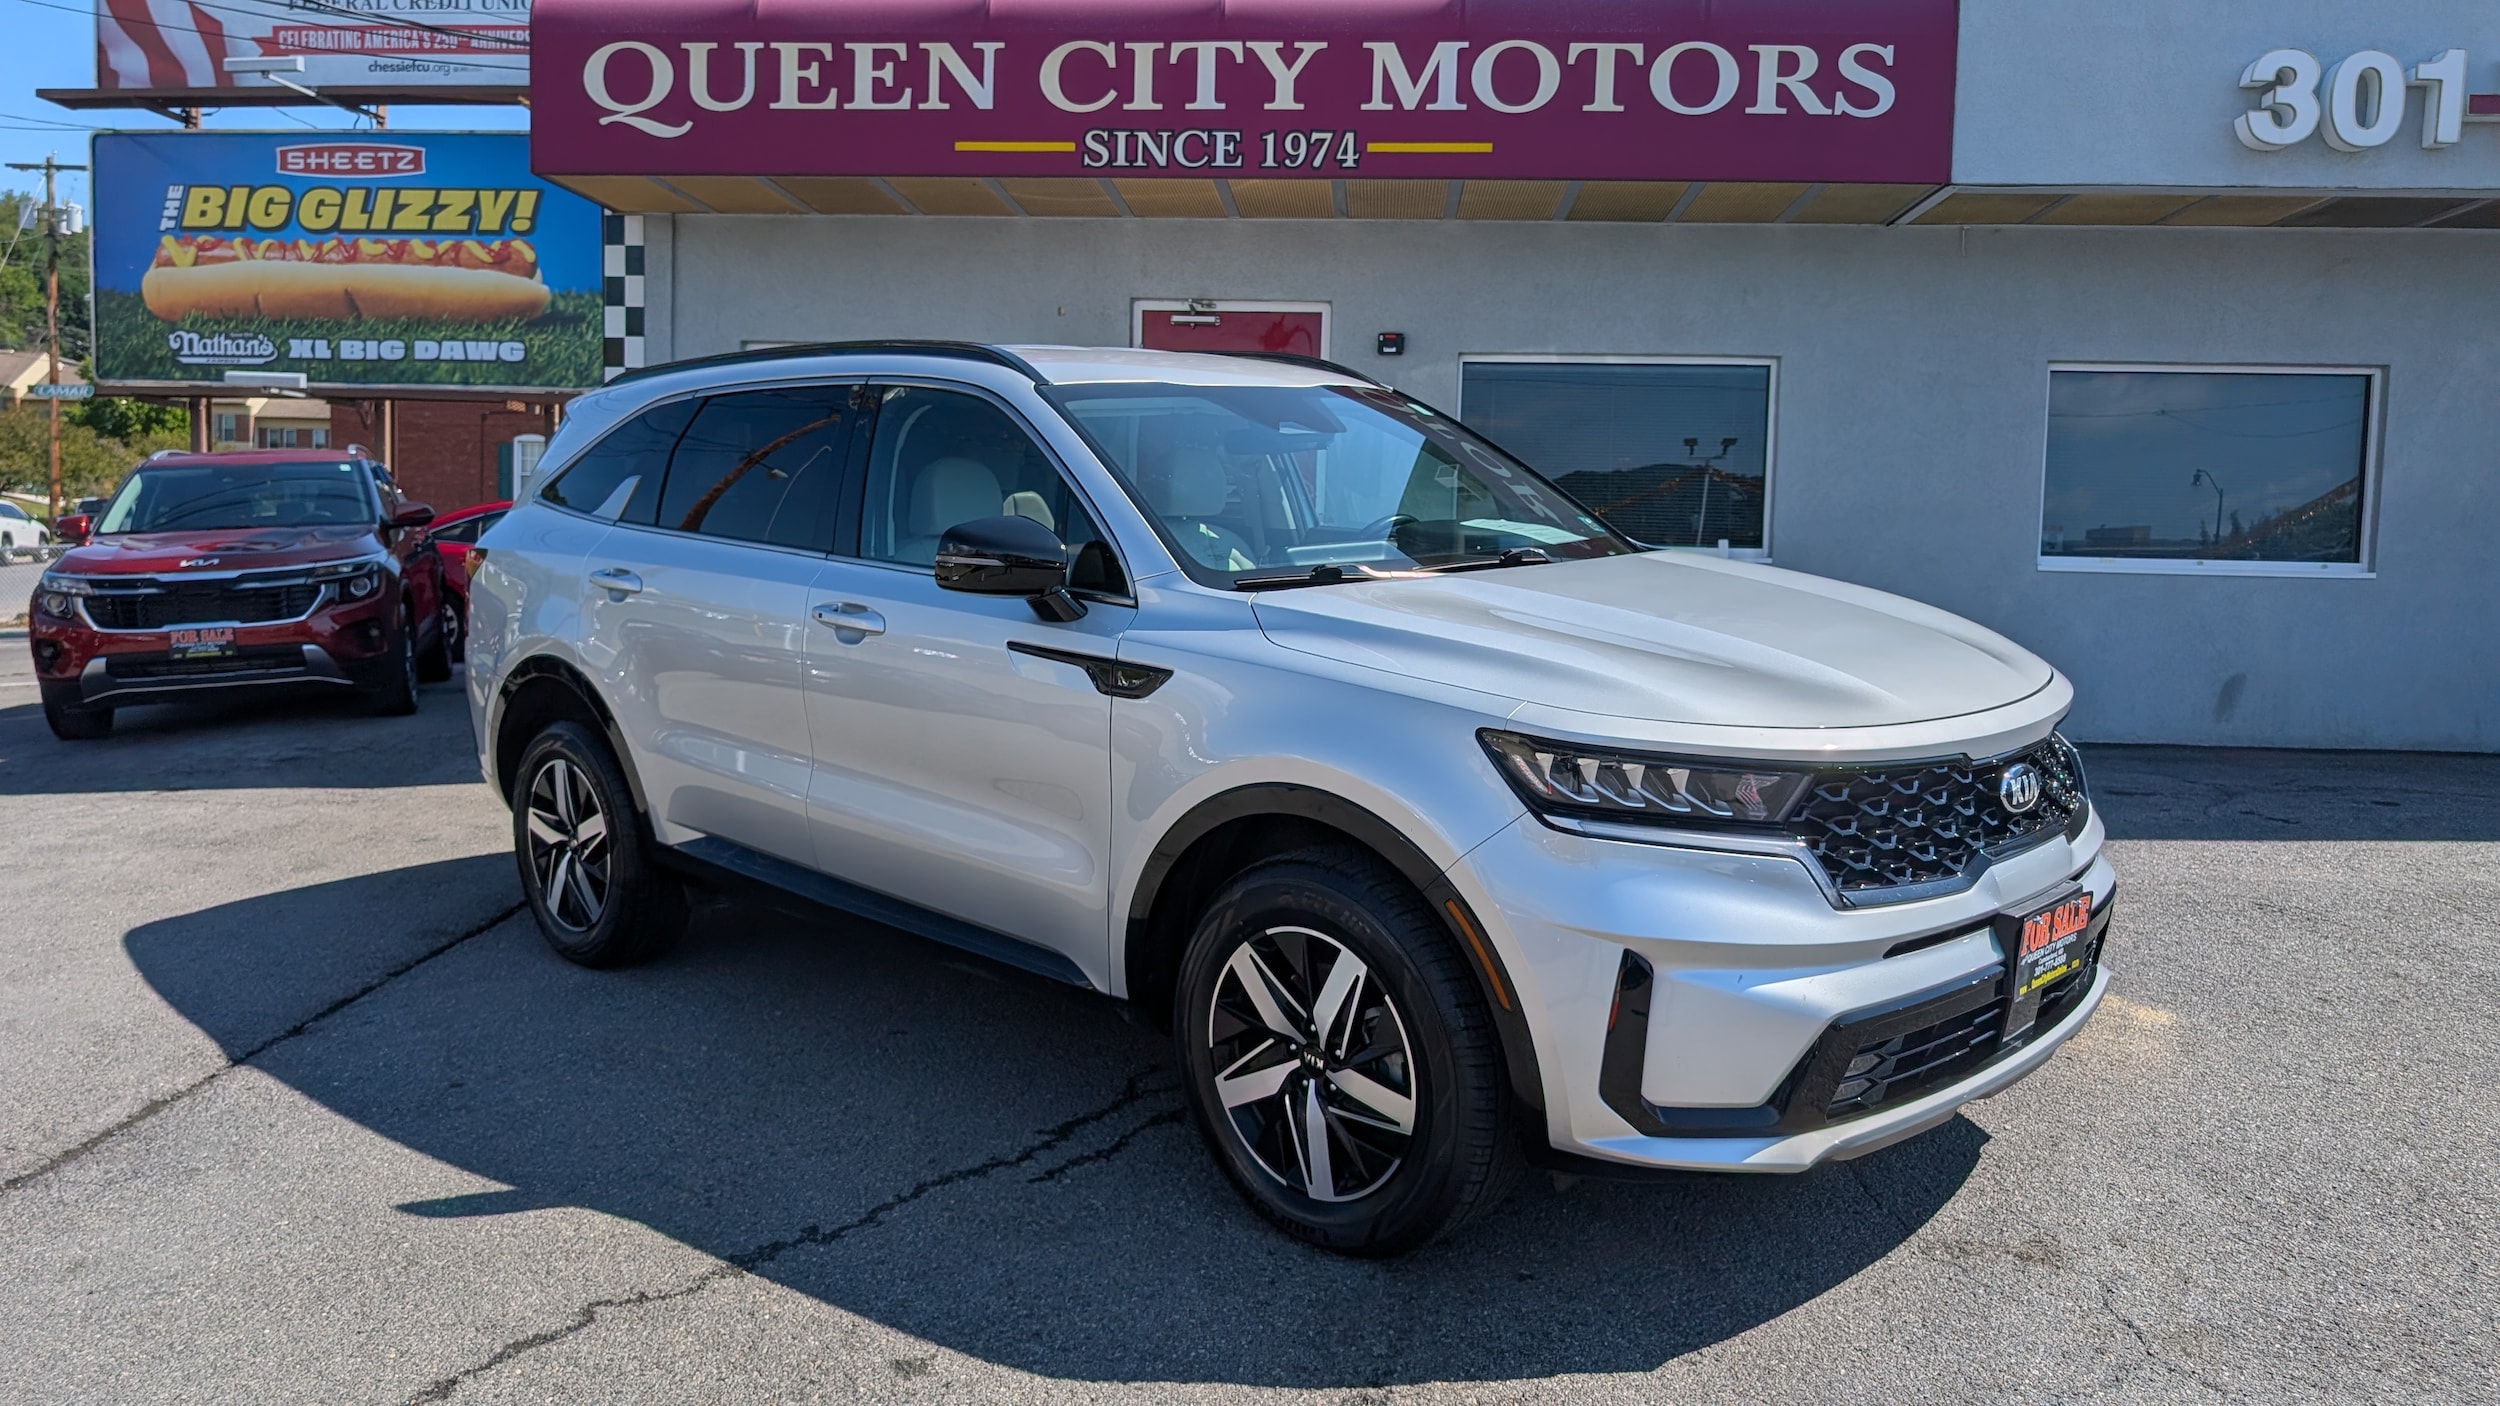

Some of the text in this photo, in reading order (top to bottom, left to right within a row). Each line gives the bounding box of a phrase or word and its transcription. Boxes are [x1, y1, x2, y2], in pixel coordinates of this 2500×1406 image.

[278, 30, 361, 49] CELEBRATING
[364, 29, 431, 49] AMERICA'S
[582, 40, 1896, 138] QUEEN CITY MOTORS
[286, 151, 415, 171] SHEETZ
[1083, 129, 1360, 168] SINCE 1974
[159, 184, 184, 231] THE
[181, 186, 539, 232] BIG GLIZZY!
[168, 331, 526, 362] Nathan's XL BIG DAWG
[38, 385, 89, 397] LAMAR
[170, 630, 198, 644] FOR
[200, 628, 234, 642] SALE
[2010, 772, 2038, 805] KIA
[2021, 895, 2091, 957] FOR SALE
[2045, 942, 2056, 955] CITY
[1303, 1051, 1324, 1070] KIA
